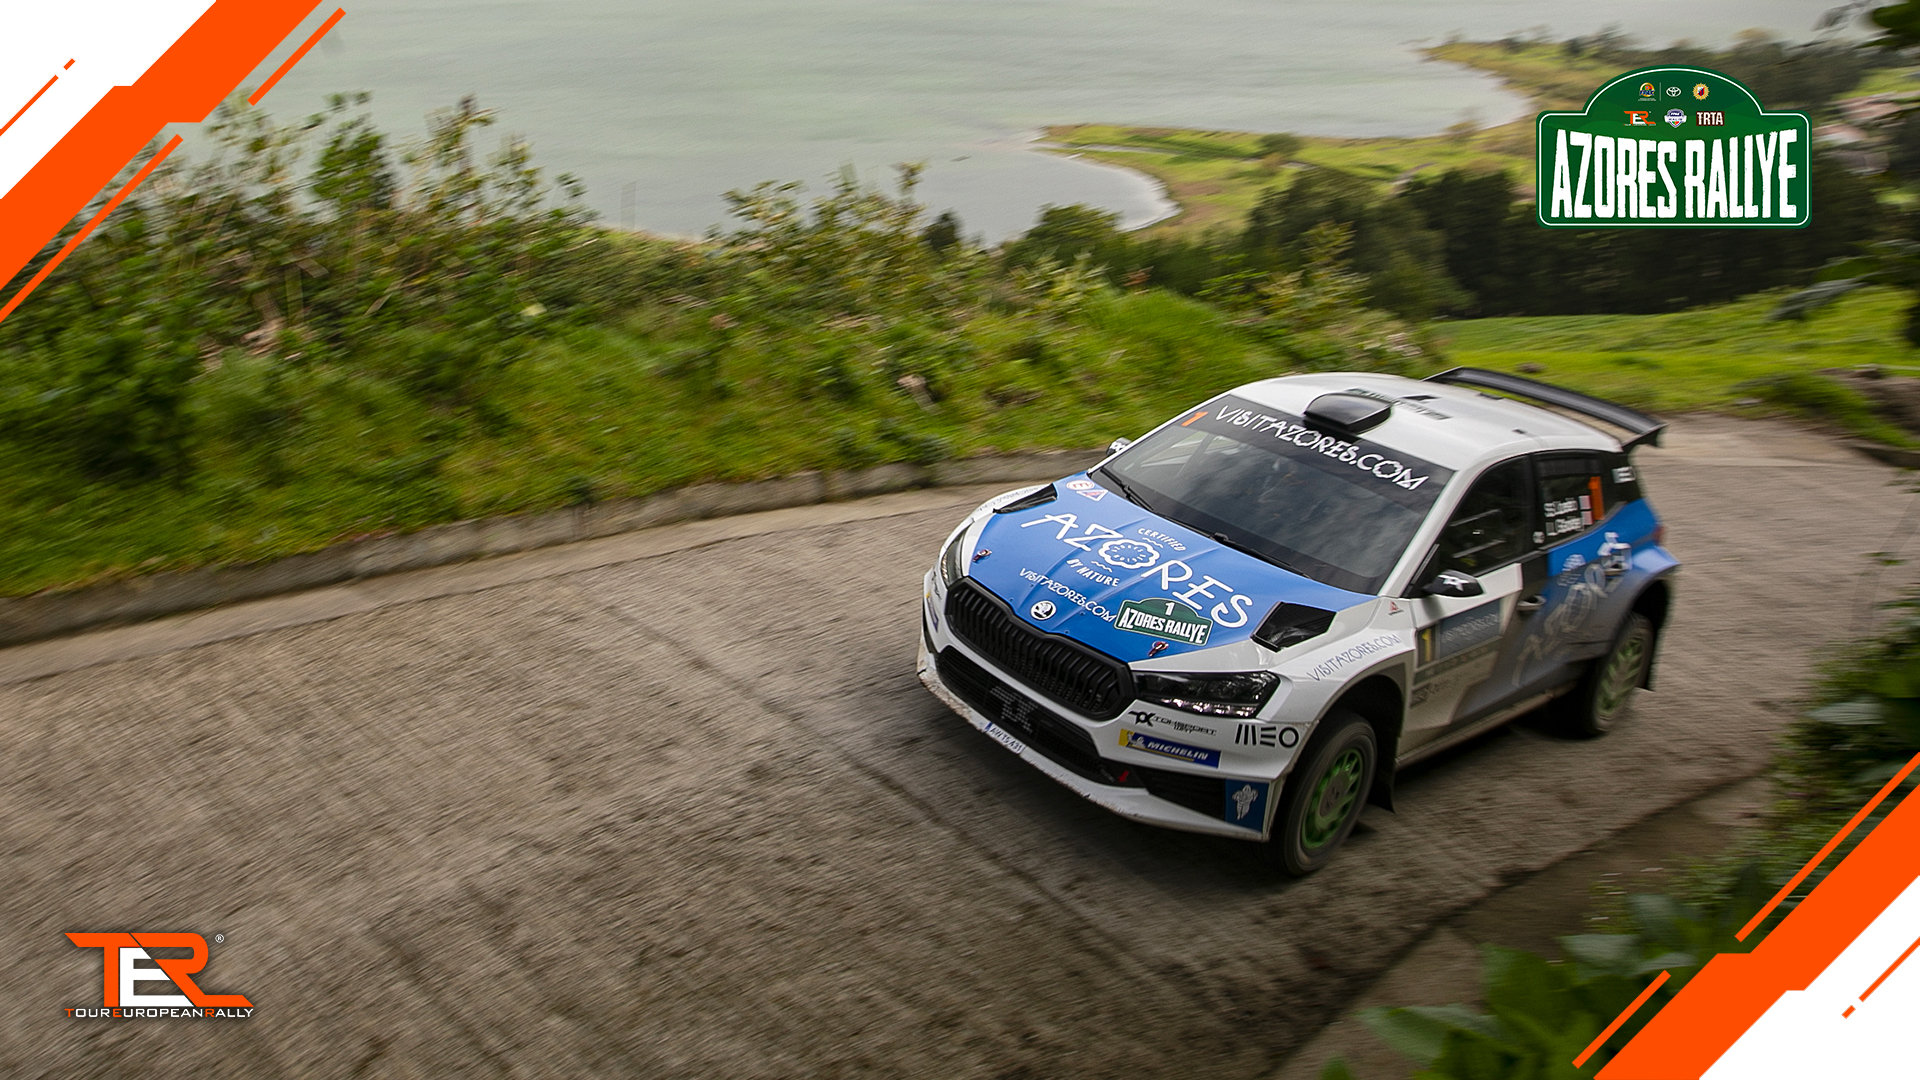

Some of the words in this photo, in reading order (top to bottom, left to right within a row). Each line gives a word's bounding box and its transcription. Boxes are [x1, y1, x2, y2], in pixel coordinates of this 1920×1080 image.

[1181, 411, 1209, 427] 1
[1215, 405, 1429, 491] VISITAZORES.COM
[1138, 527, 1187, 551] CERTIFIED
[1020, 513, 1253, 628] AZORES
[1066, 558, 1083, 568] BY
[1076, 566, 1120, 587] NATURE
[1020, 568, 1117, 623] VISITAZORES.COM
[1165, 602, 1175, 616] 1
[1118, 607, 1166, 631] AZORES
[1164, 620, 1208, 644] RALLYE
[1234, 722, 1300, 748] MEO
[1147, 741, 1209, 761] MICHELIN
